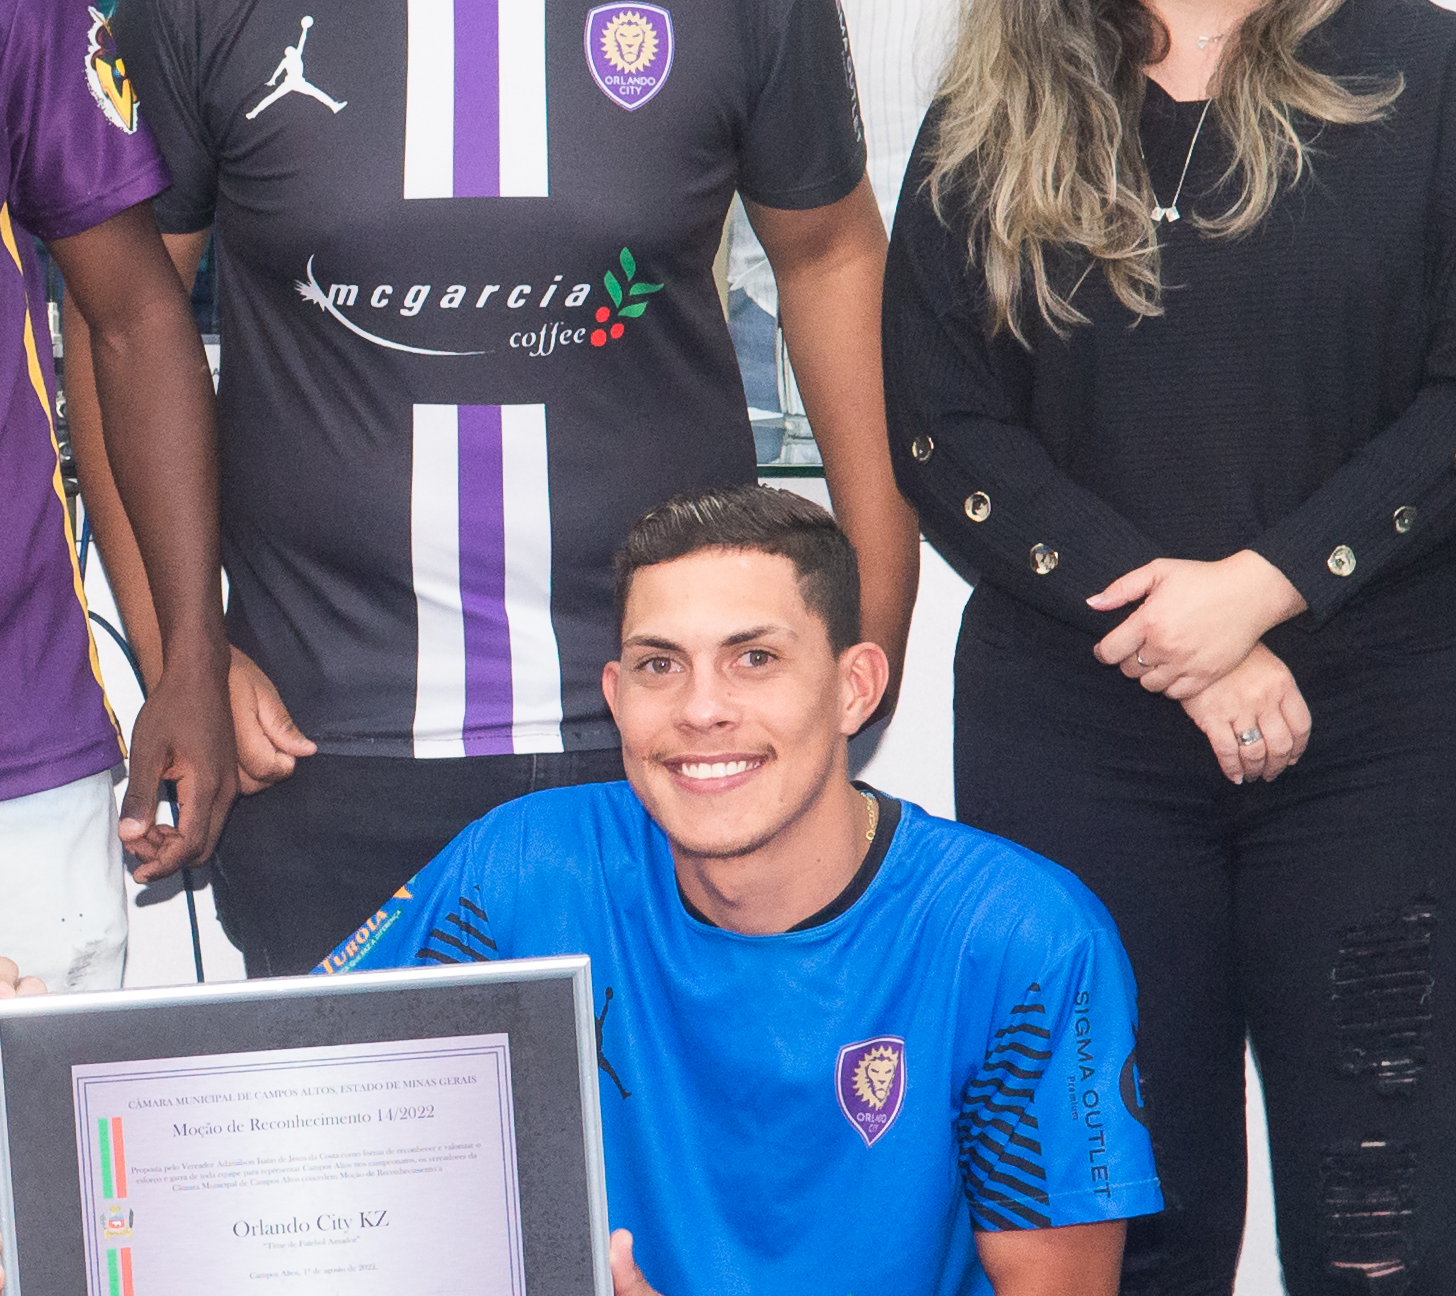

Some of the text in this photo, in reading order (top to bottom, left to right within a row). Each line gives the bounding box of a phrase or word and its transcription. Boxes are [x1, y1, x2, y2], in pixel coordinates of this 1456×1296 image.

[605, 75, 656, 86] ORLANDO
[619, 86, 642, 95] CITY
[327, 274, 592, 317] mcgarcia
[509, 321, 587, 357] coffee
[320, 910, 387, 974] TUROLA
[127, 1074, 477, 1109] CÂMARA MUNICIPAL DE CAMPOS ALTOS, ESTADO DE MINAS GERAIS
[1067, 1075, 1079, 1121] Premium
[1075, 991, 1111, 1199] SIGMA OUTLET
[172, 1104, 435, 1139] Moção de Reconhecimento 14/2022
[231, 1209, 389, 1237] Orlando City KZ
